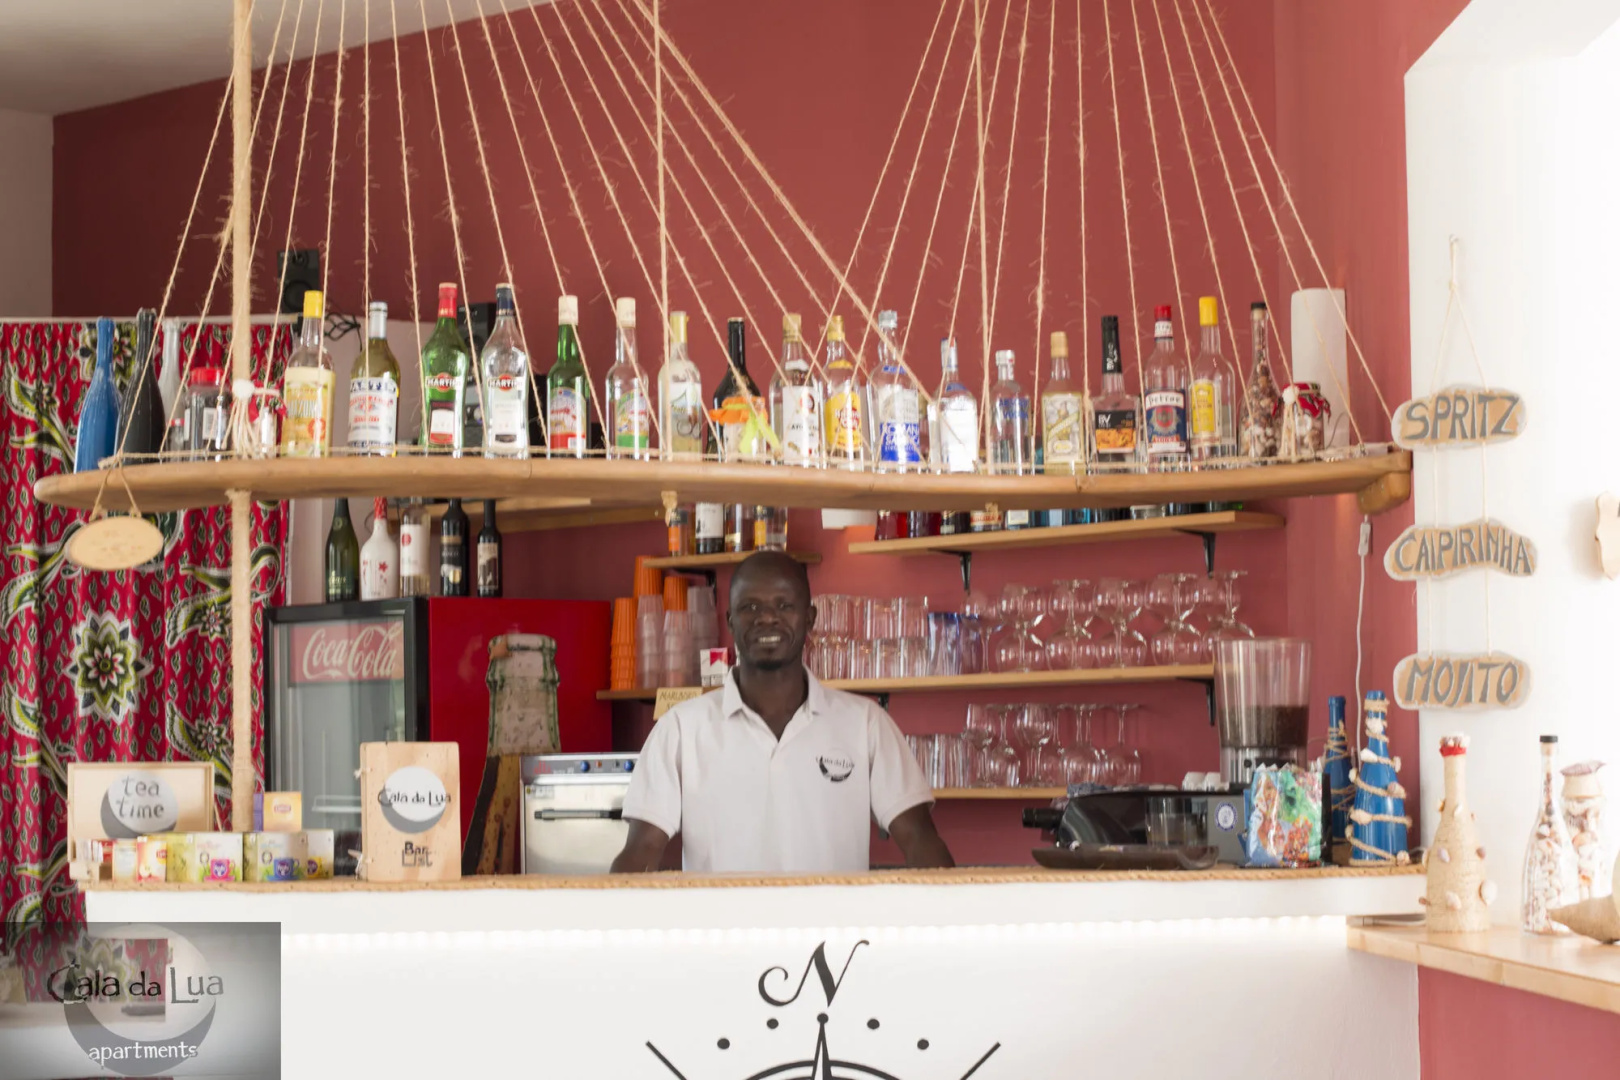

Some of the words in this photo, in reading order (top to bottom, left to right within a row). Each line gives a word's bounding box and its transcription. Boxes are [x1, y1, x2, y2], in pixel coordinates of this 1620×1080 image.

[427, 377, 460, 388] MARTI
[488, 377, 521, 388] MARTI
[1405, 393, 1519, 440] SPRITZ
[1394, 524, 1532, 574] CAIPIRINHA
[1405, 659, 1519, 704] MOJITO
[121, 776, 160, 797] tea
[116, 796, 164, 818] time
[378, 789, 408, 806] Cala
[412, 791, 425, 803] da
[428, 790, 452, 806] Lua
[404, 841, 428, 855] Bar
[758, 939, 870, 1008] N
